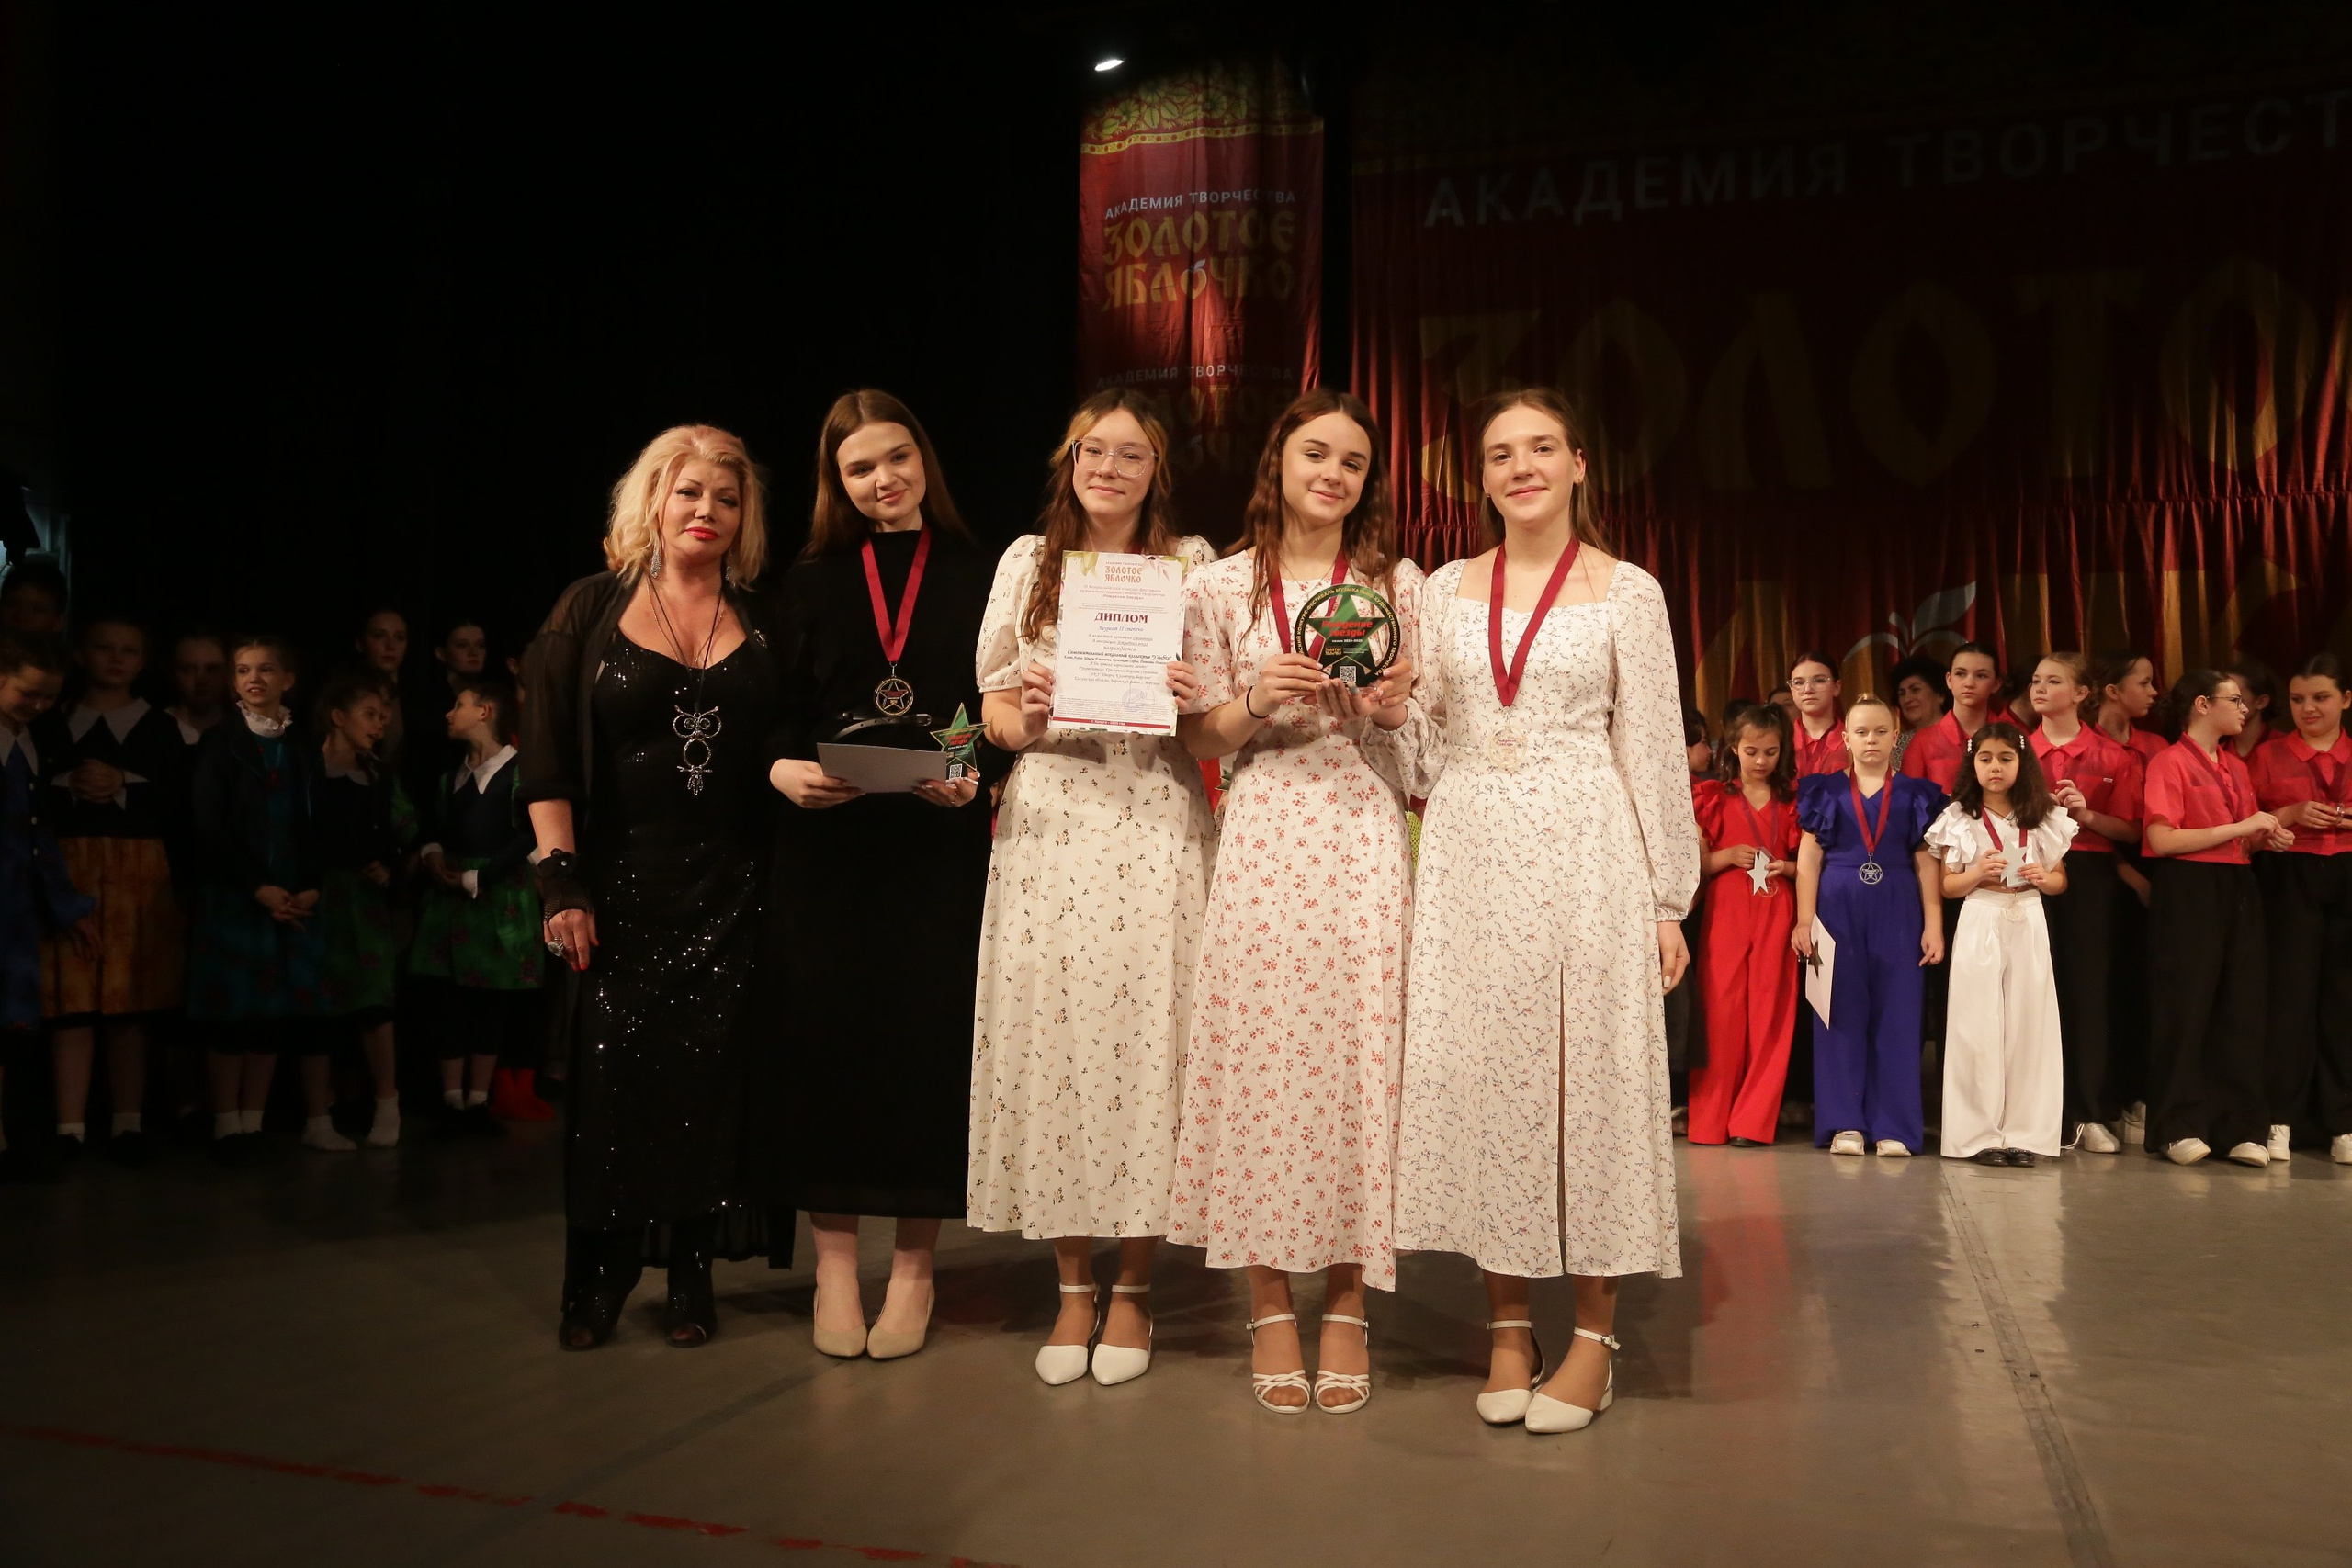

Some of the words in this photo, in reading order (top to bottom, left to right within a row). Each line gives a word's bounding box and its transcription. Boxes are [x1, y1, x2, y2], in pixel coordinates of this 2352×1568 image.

[1423, 140, 1848, 228] АКАДЕМИЯ
[1884, 88, 2352, 190] ТВОРЧЕСТ
[1104, 194, 1183, 220] АКАДЕМИЯ
[1102, 207, 1297, 265] ЗОЛОТОЕ
[1100, 254, 1296, 312] ЯБЛОЧКО
[1096, 367, 1179, 389] АКАДЕМИЯ
[1416, 253, 2352, 504] ЗОЛОТО
[1104, 565, 1143, 575] ЗОЛОТОЕ
[1104, 574, 1142, 583] ЯБЛОЧКО
[1094, 612, 1148, 624] ДИПЛОМ
